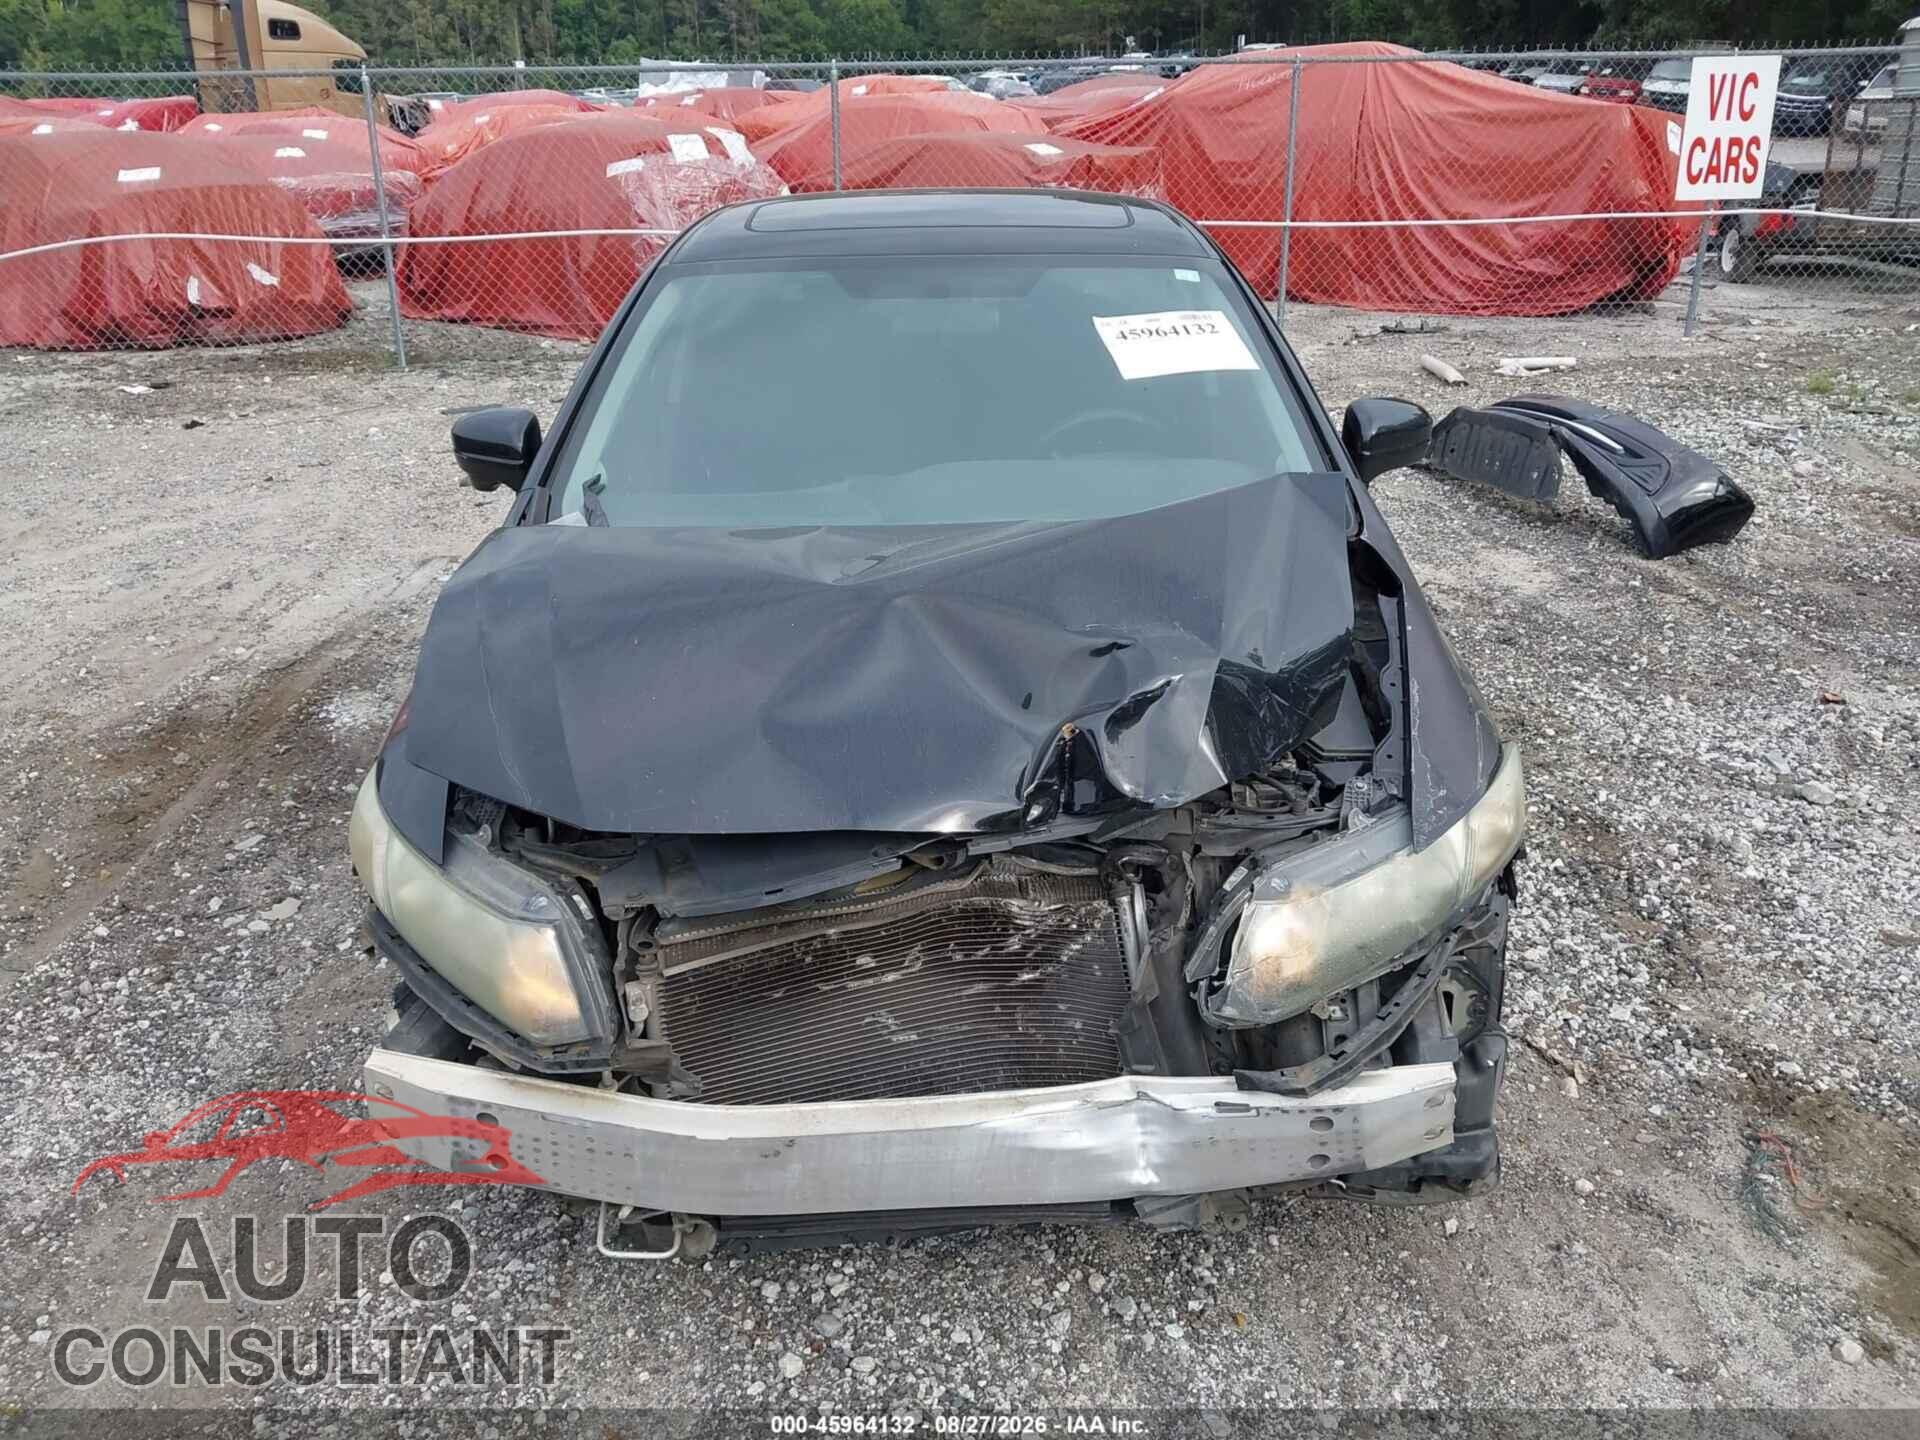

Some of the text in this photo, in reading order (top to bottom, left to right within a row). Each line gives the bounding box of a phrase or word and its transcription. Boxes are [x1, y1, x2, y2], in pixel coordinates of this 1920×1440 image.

[1709, 72, 1759, 121] VIC
[1686, 135, 1761, 185] CARS
[1115, 322, 1220, 341] 45964132
